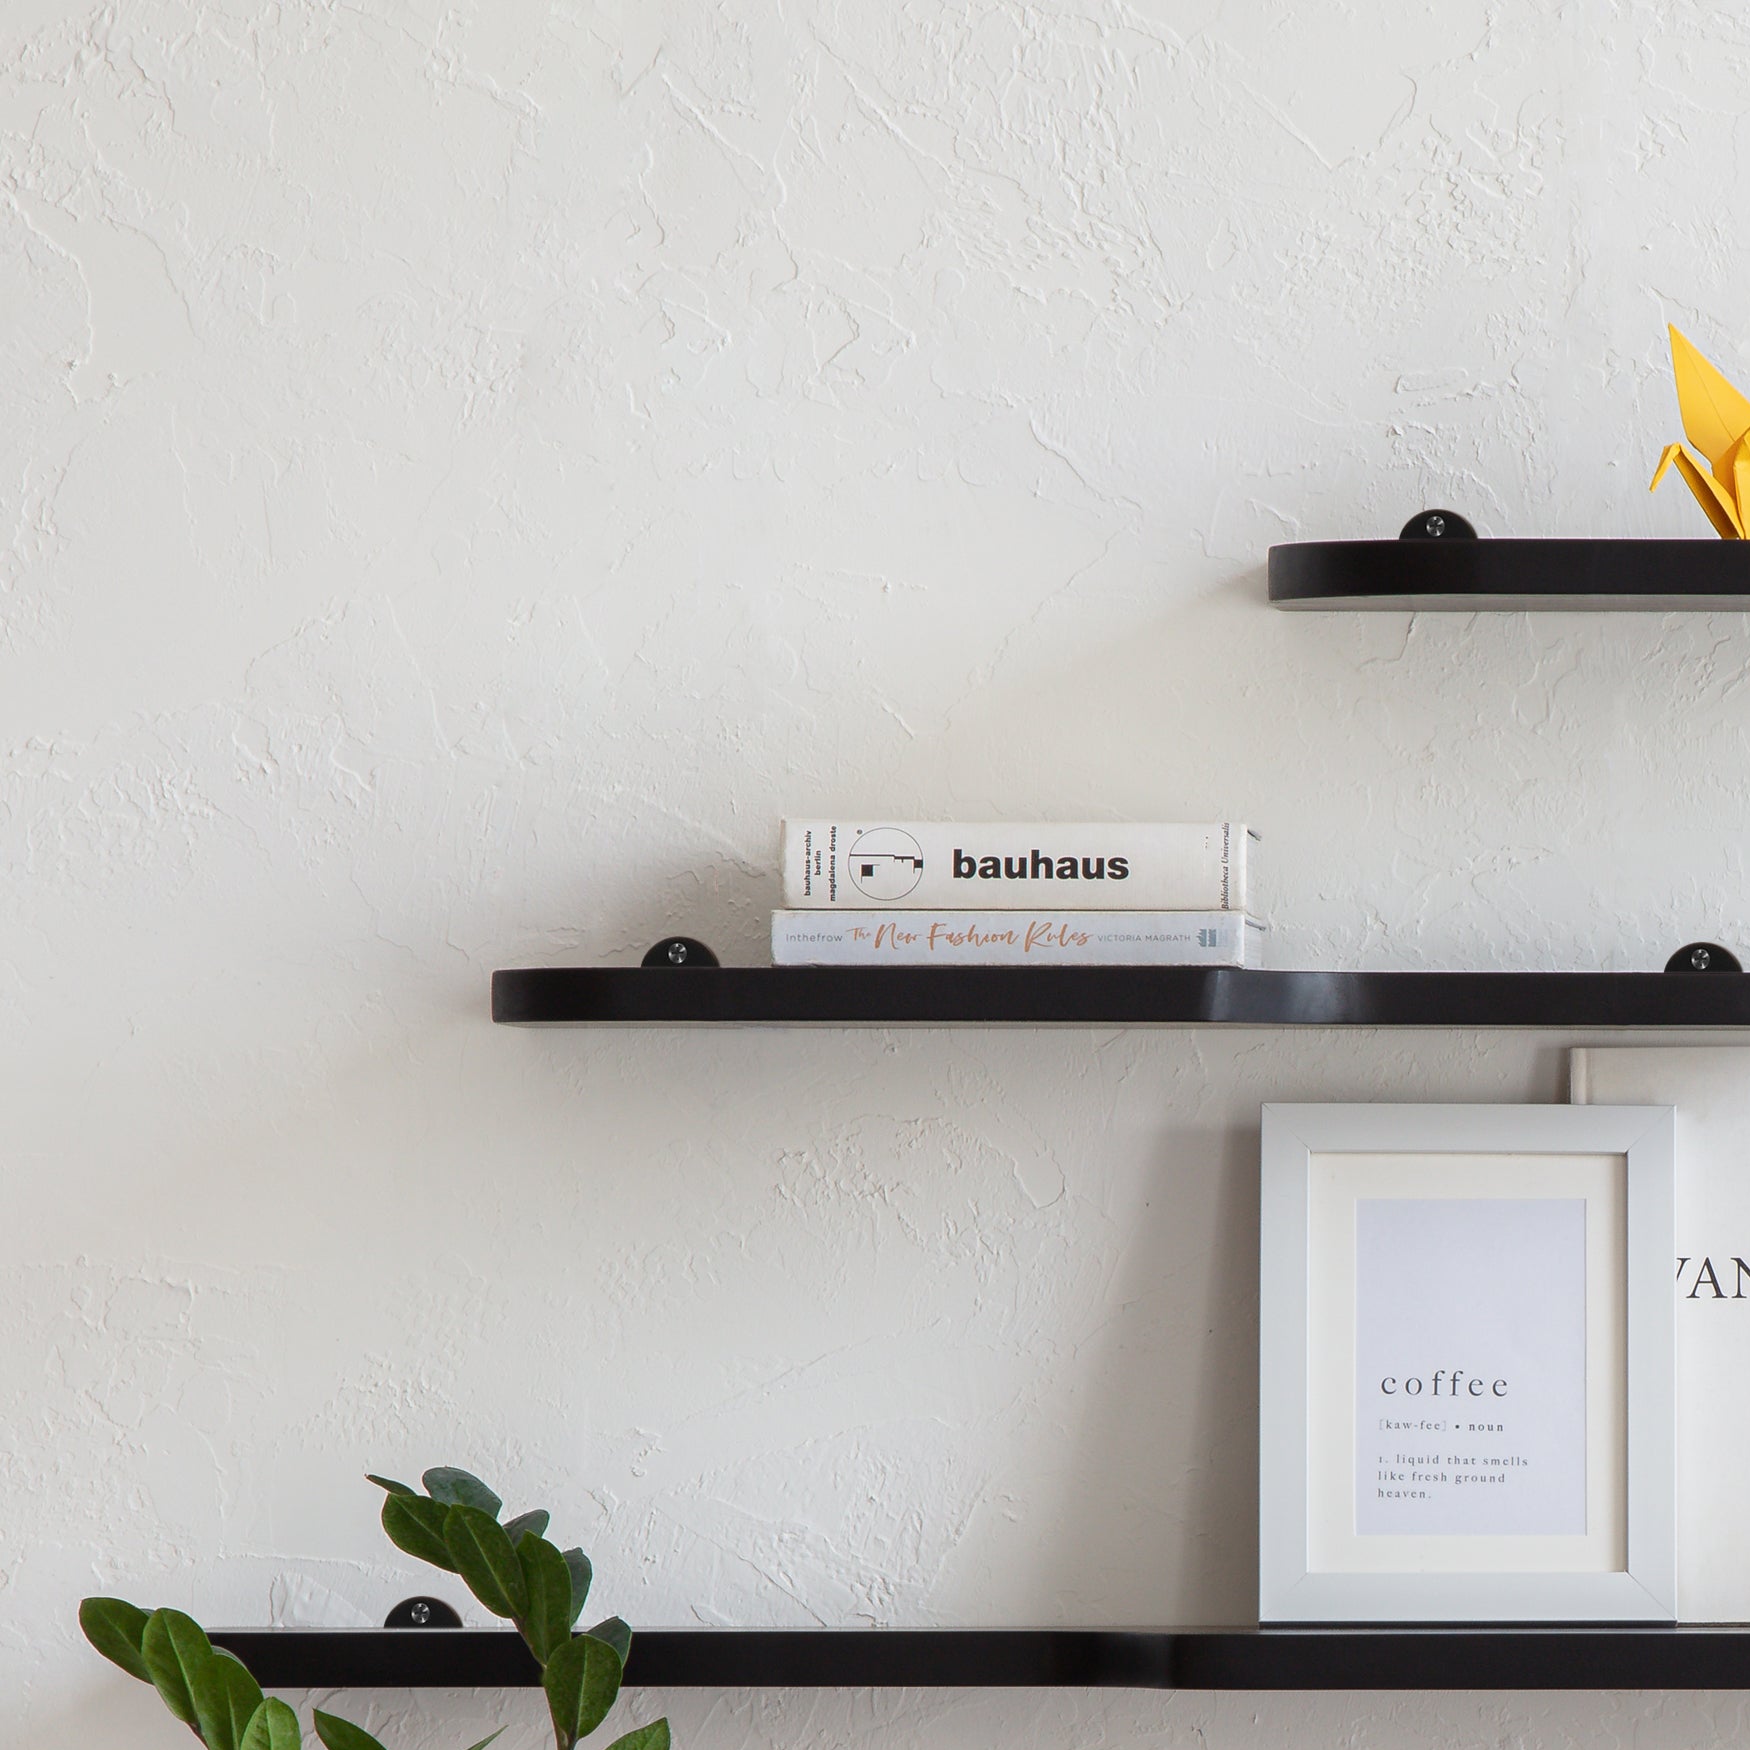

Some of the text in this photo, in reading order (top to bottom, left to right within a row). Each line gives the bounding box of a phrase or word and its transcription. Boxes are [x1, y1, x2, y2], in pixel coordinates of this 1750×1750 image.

[804, 830, 812, 897] bauhaus-archiv
[828, 825, 837, 902] magdalena droste
[953, 848, 1130, 880] bauhaus
[1220, 823, 1229, 910] Bibliotheca Universalis
[786, 921, 1191, 952] Inthefrow The New Fashion Rules VICTORIA MAGRATH
[1381, 1370, 1508, 1397] coffee
[1379, 1419, 1504, 1432] [kaw-fee] noun
[1396, 1454, 1440, 1467] liquid
[1447, 1455, 1477, 1465] that
[1482, 1457, 1528, 1466] smells
[1378, 1471, 1505, 1485] like fresh ground
[1377, 1488, 1432, 1499] heaven.
